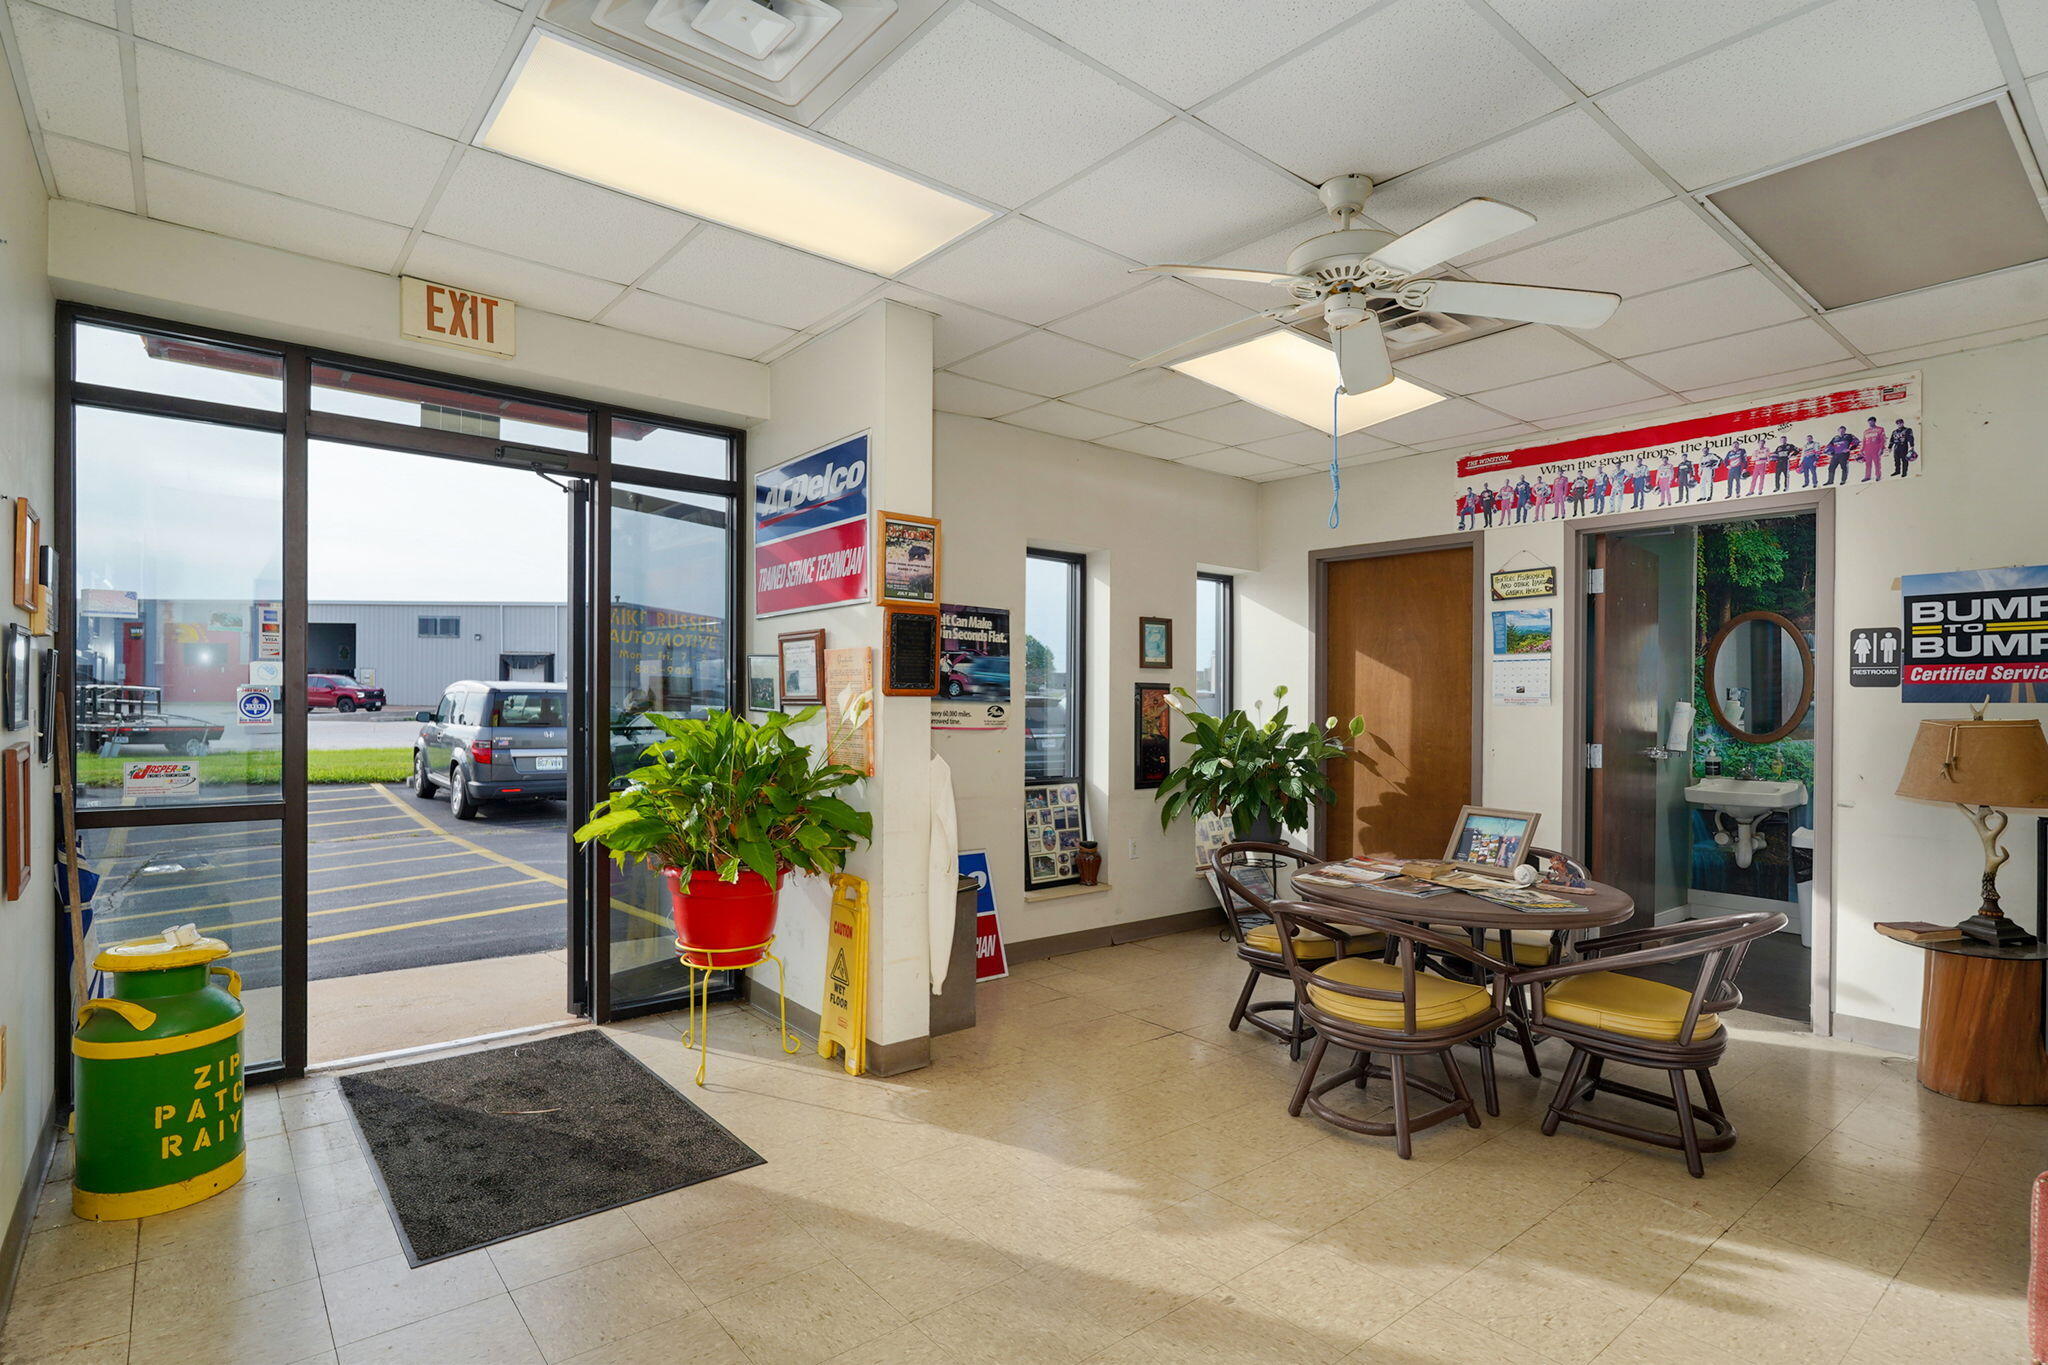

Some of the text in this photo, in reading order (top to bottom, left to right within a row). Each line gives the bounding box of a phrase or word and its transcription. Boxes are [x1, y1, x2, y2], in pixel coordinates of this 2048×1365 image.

[426, 284, 499, 344] EXIT
[1467, 459, 1480, 468] THE
[1479, 454, 1510, 465] WINSTON
[1540, 428, 1777, 475] When the green drops, the bull stops.
[761, 460, 866, 517] ACDelco
[758, 564, 787, 592] TRAINED
[785, 556, 817, 588] SERVICE
[815, 546, 865, 582] TECHNICIAN
[656, 611, 720, 633] RUSSELL
[951, 614, 968, 627] Can
[968, 616, 993, 630] Make
[1944, 623, 1984, 634] TO
[611, 628, 719, 649] AUTOMOTIVE
[943, 626, 1008, 644] in Seconds Flat.
[1910, 666, 1986, 682] Certified
[958, 710, 972, 718] miles.
[132, 764, 178, 780] JASPER
[833, 920, 854, 940] CAUTION
[833, 982, 846, 997] WET
[829, 994, 848, 1011] FLOOR
[193, 1053, 241, 1091] ZIP
[155, 1080, 243, 1130] PATC
